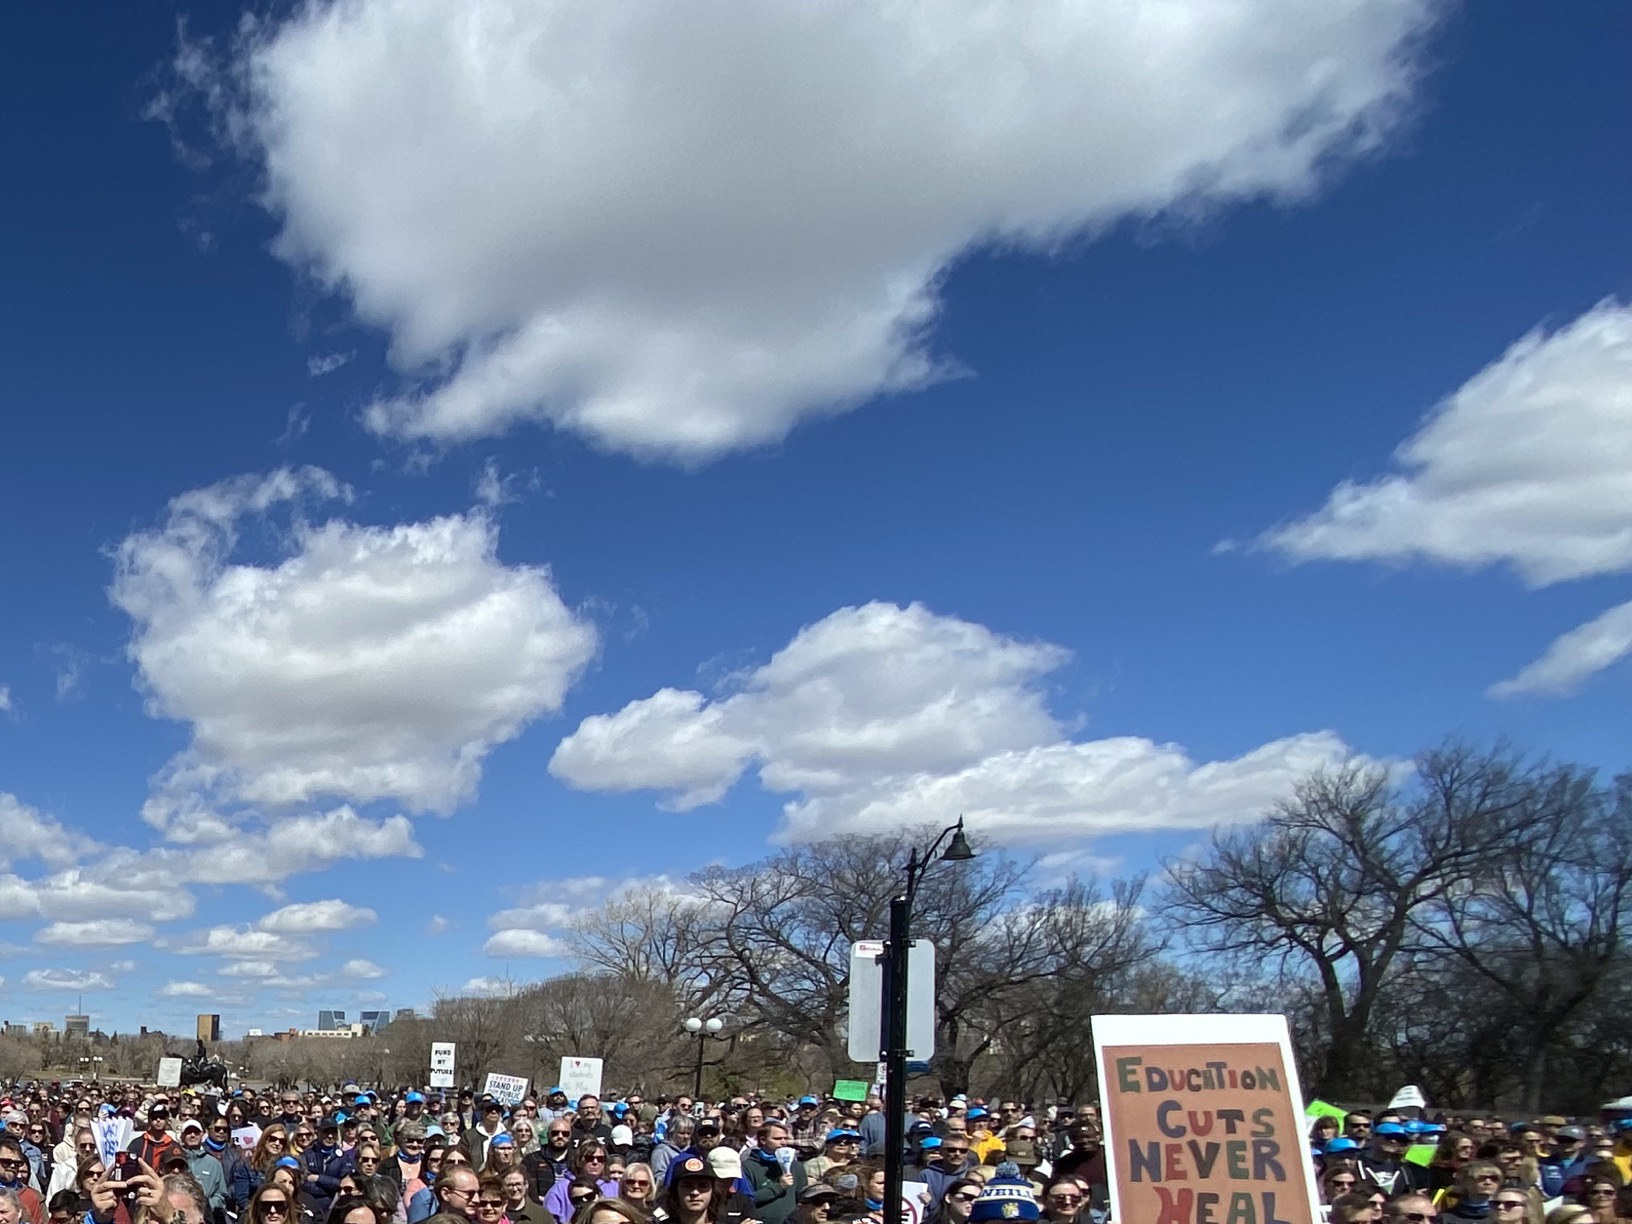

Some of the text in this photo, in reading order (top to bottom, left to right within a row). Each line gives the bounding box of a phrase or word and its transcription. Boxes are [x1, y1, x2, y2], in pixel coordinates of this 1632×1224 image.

[489, 1080, 523, 1092] STAND UP
[1116, 1056, 1282, 1094] EDUCATION
[1156, 1100, 1276, 1139] CUTS
[1128, 1139, 1287, 1184] NEVER
